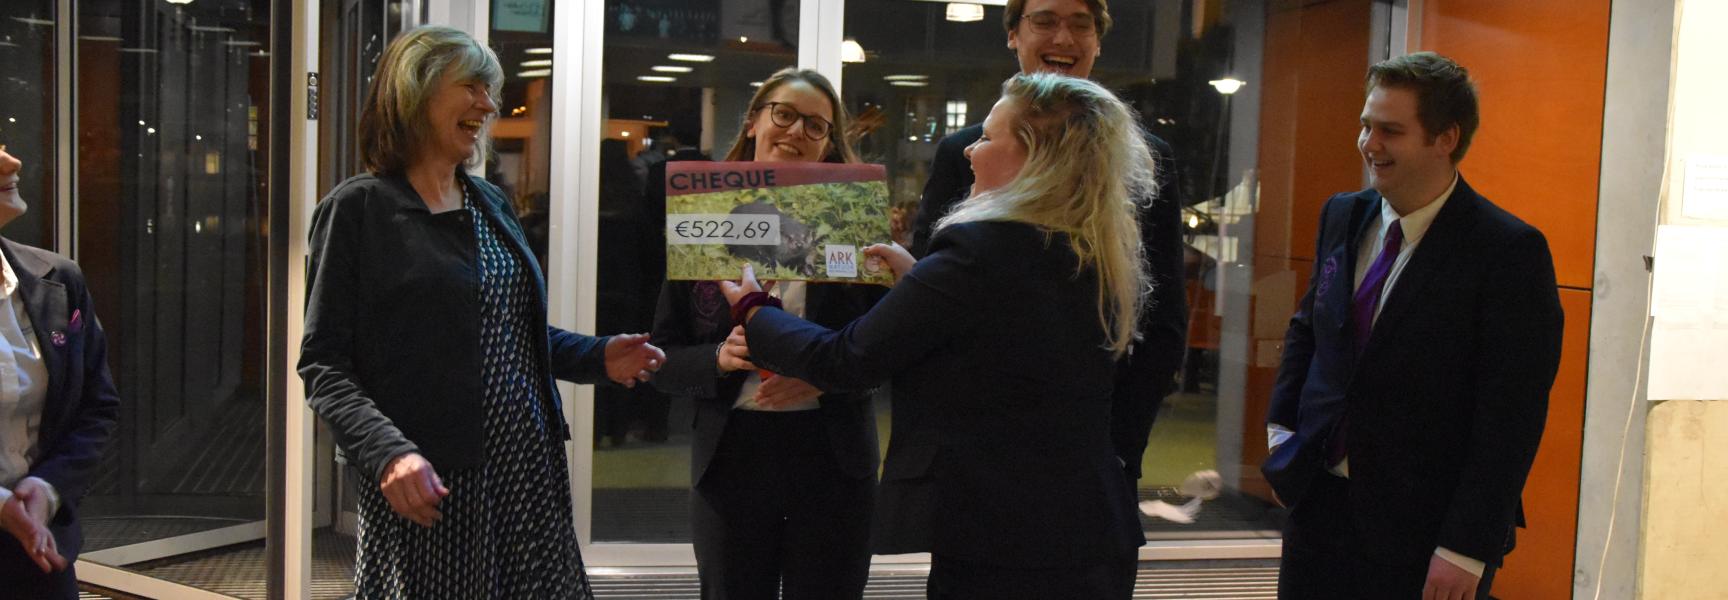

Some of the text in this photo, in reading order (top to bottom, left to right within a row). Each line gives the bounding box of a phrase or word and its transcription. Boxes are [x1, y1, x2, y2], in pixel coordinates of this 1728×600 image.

[670, 169, 776, 190] CHEQUE
[675, 220, 770, 239] €522,69
[829, 251, 853, 265] ARK
